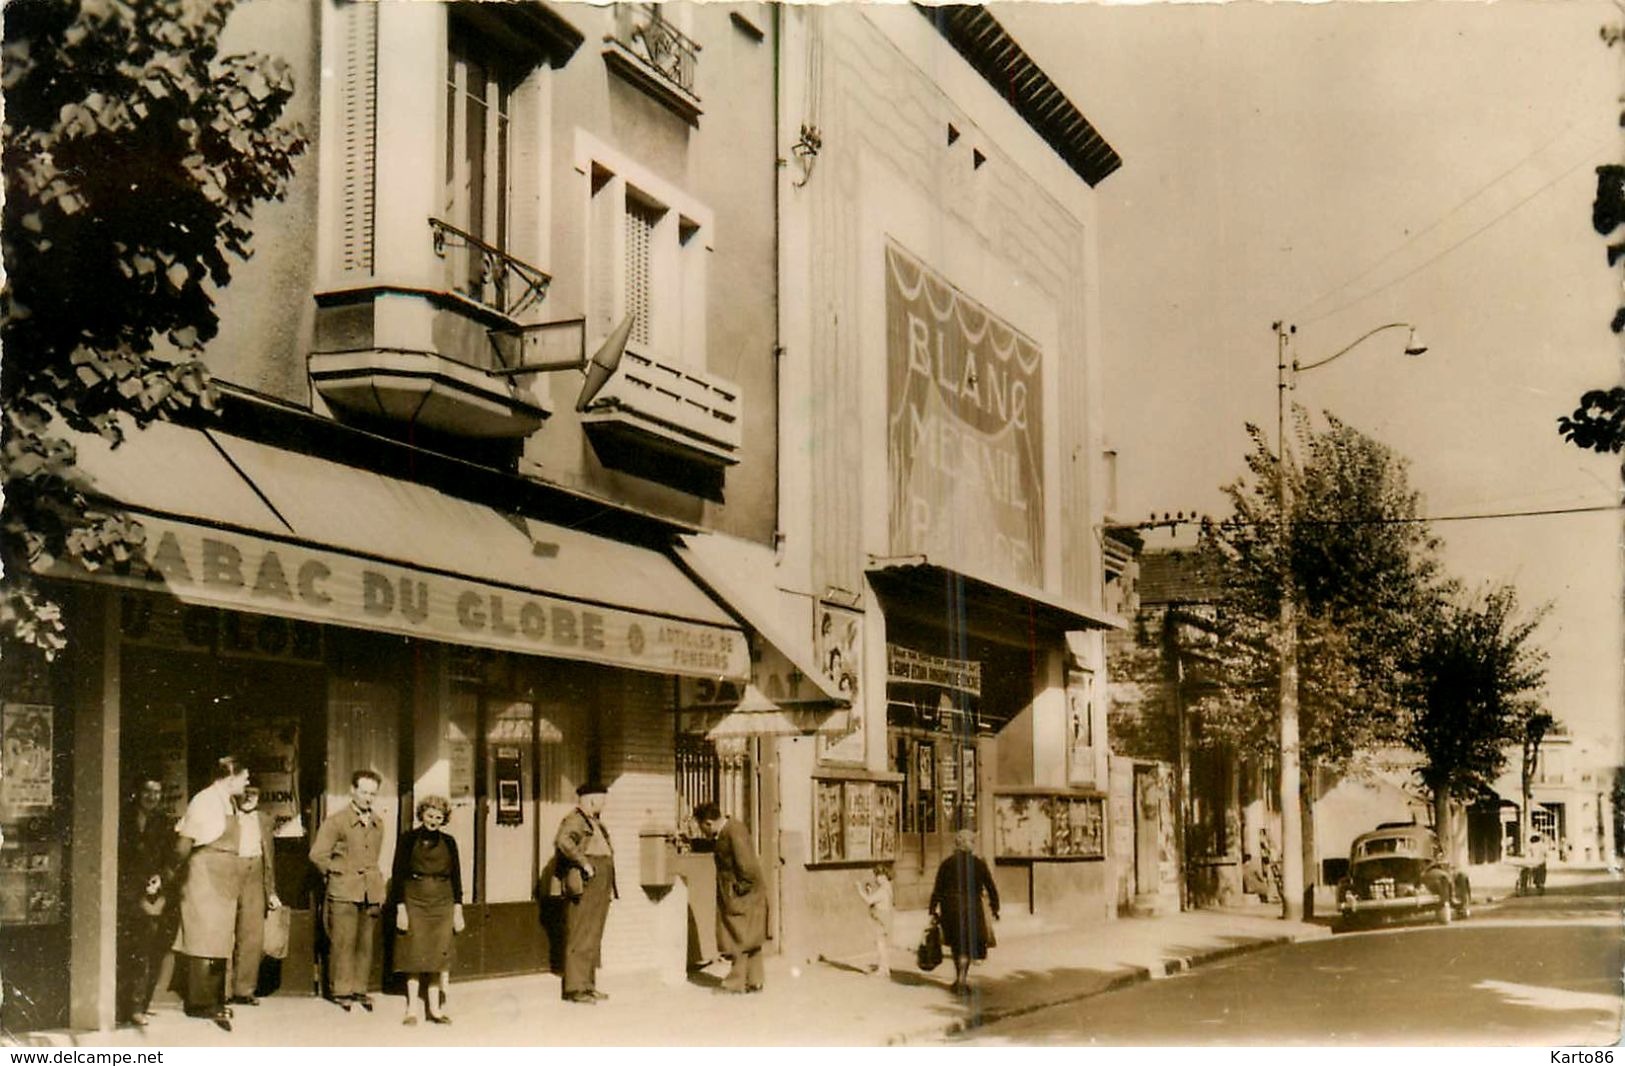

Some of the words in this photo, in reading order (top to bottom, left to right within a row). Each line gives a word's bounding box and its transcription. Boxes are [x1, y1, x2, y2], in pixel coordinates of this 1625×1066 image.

[909, 311, 1027, 430] BLANC
[909, 401, 1027, 511] MESNIL
[142, 531, 333, 606] ABAC
[362, 570, 429, 625] DU
[456, 590, 606, 650] GLOBE
[911, 497, 1028, 586] PCE
[659, 626, 715, 650] ARTICLES
[720, 636, 734, 654] DE
[673, 649, 730, 670] FUMEURS
